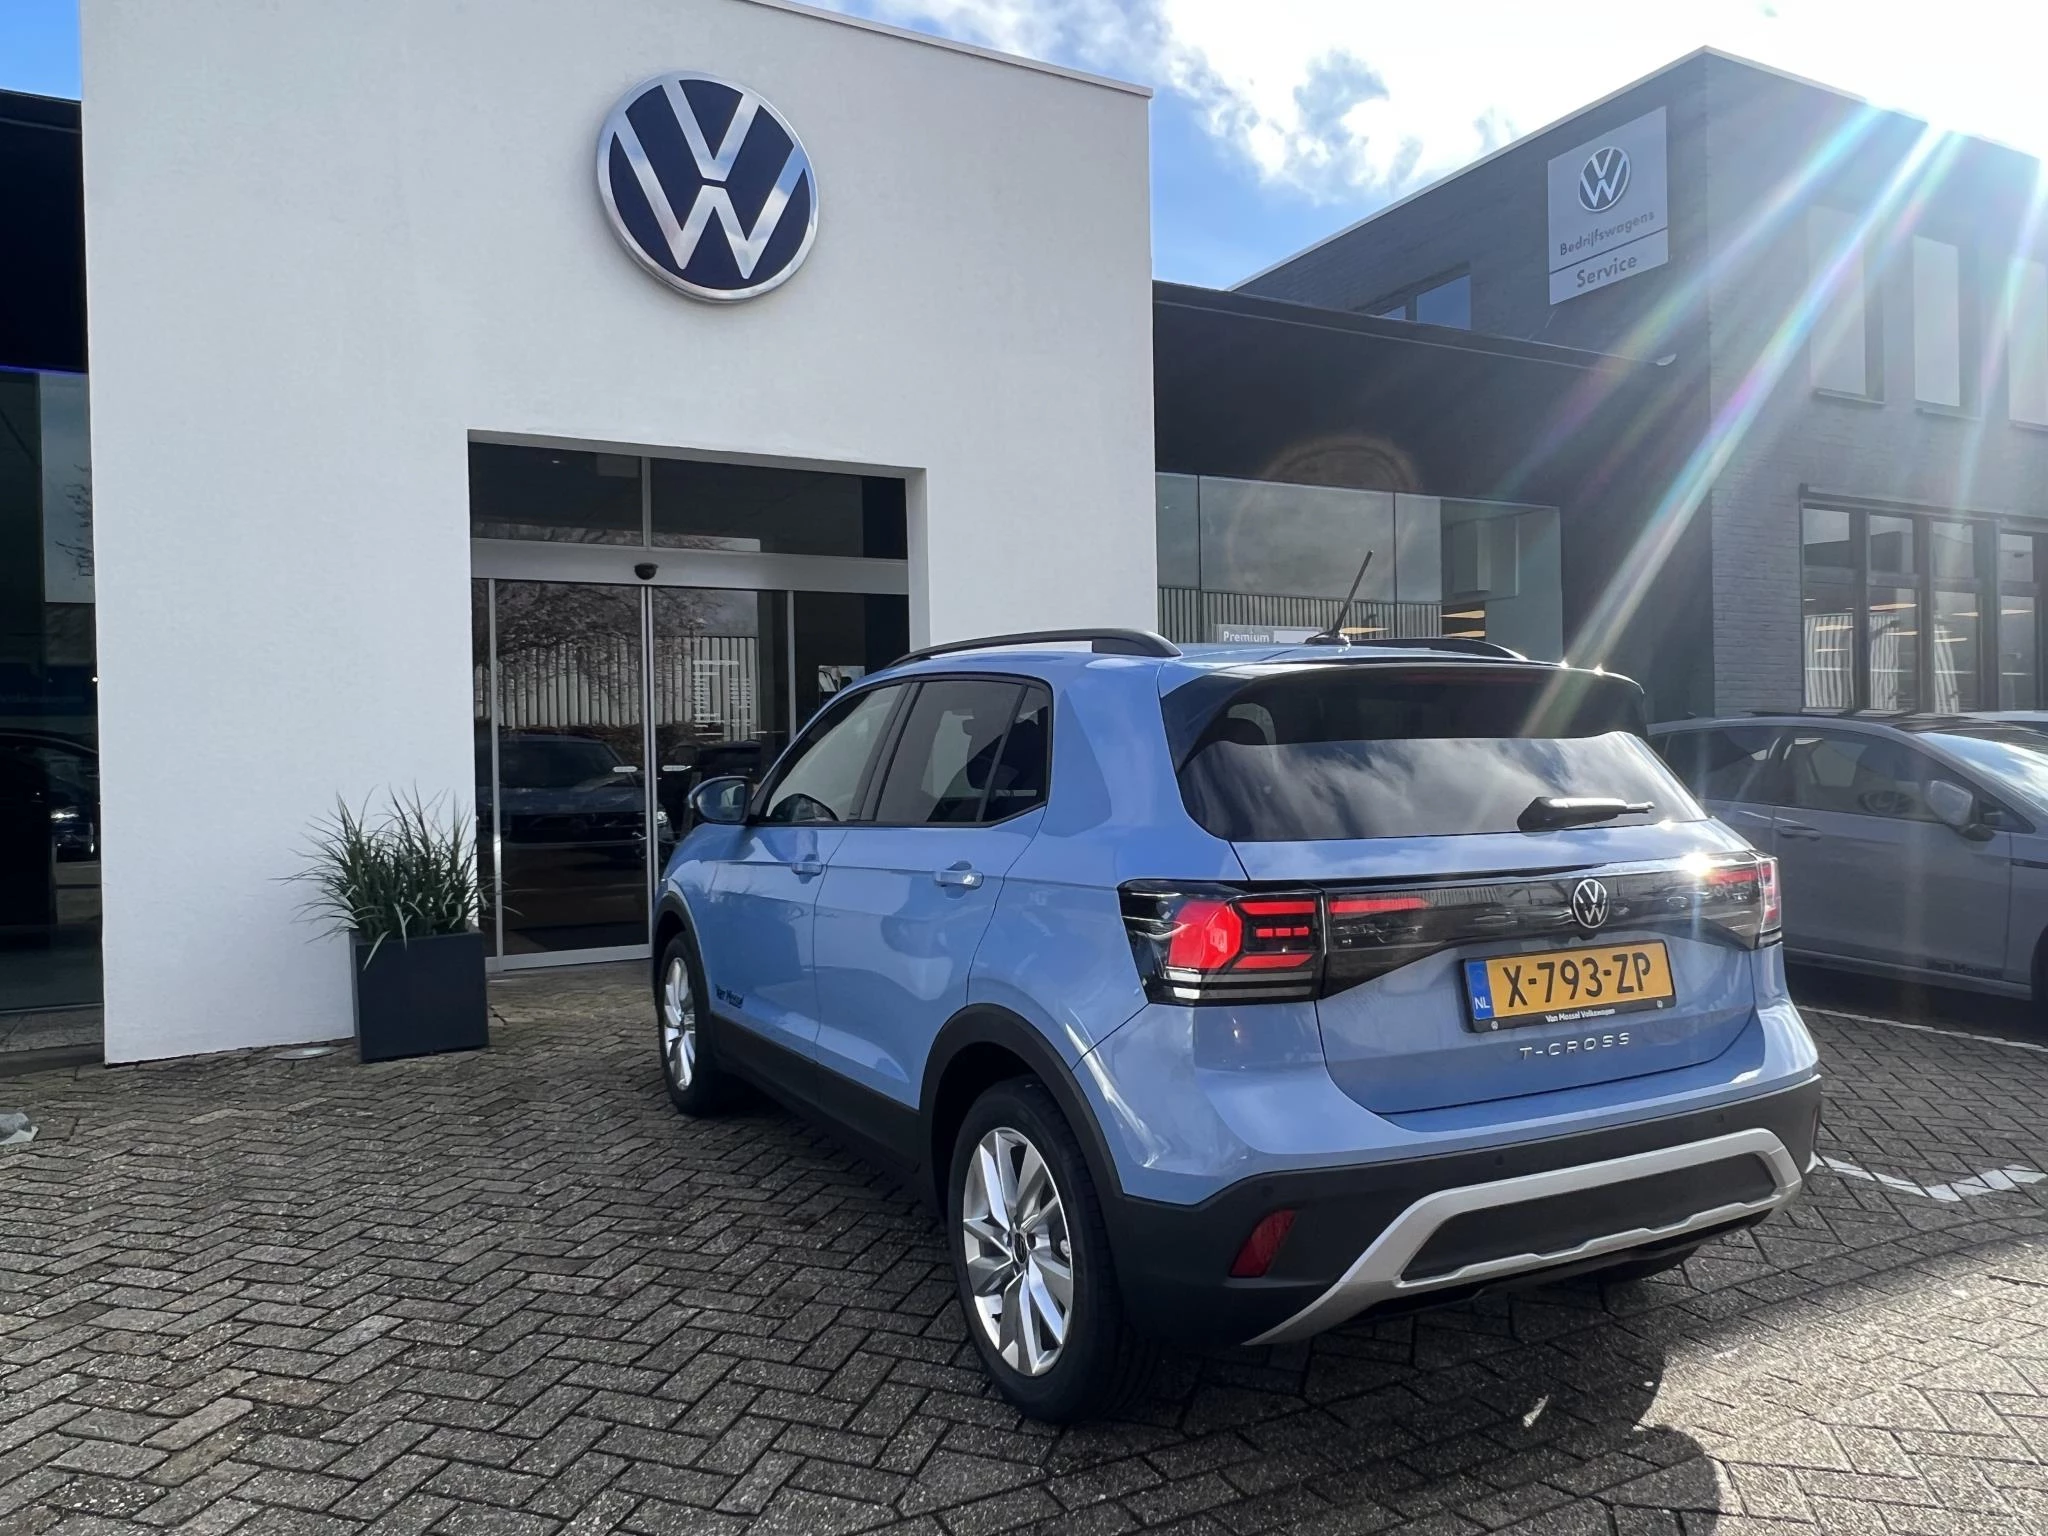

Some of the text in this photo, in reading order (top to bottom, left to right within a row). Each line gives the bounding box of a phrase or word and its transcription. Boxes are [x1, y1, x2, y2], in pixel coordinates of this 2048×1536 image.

[1559, 211, 1655, 256] Bedrijfswagens
[1576, 256, 1638, 288] Service
[1223, 630, 1270, 643] Premium
[1502, 951, 1651, 1008] X-793-ZP
[1474, 997, 1491, 1010] NL
[1519, 1032, 1630, 1060] T-CROSS
